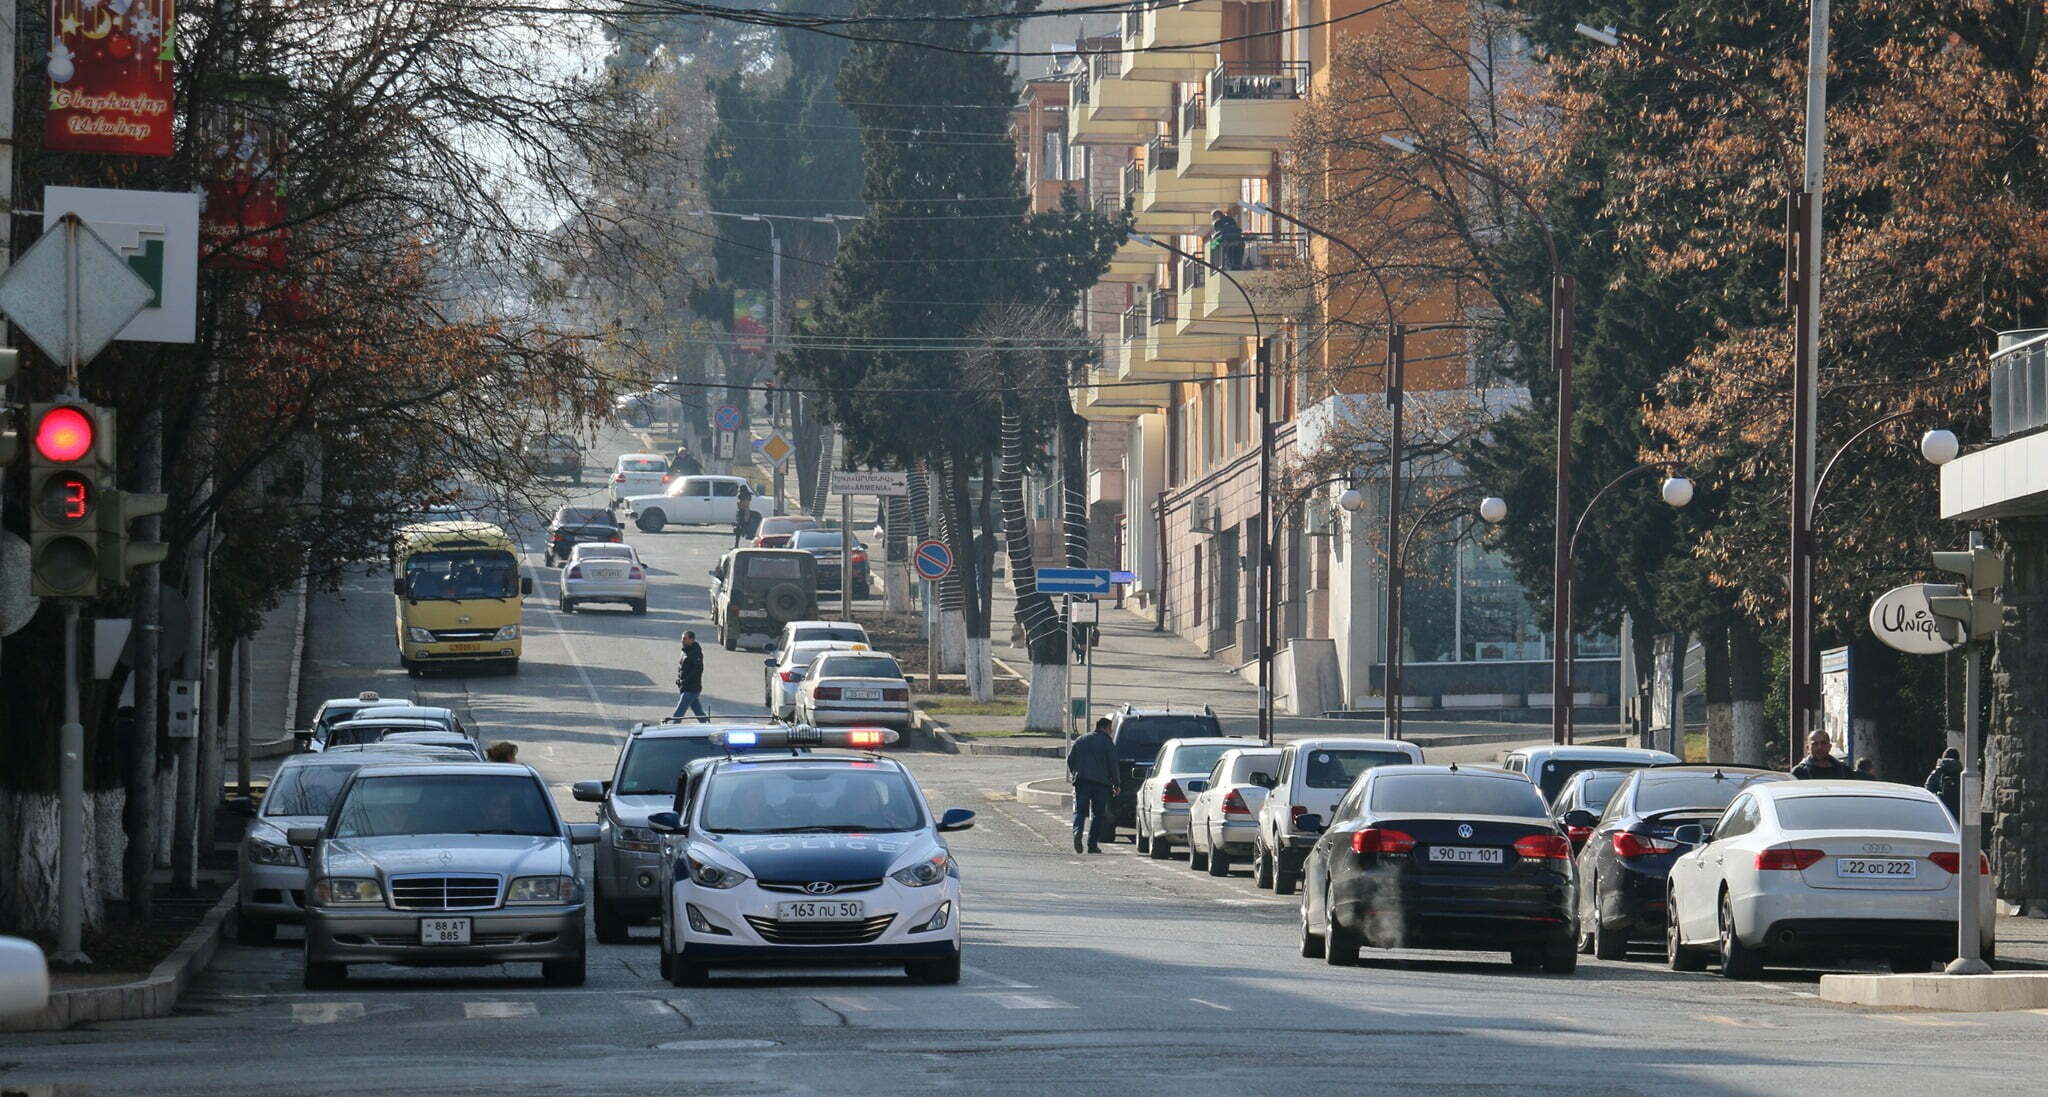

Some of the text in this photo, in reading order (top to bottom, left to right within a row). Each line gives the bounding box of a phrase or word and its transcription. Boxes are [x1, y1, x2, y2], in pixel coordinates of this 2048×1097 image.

[67, 115, 151, 140] Ամանոր
[65, 480, 86, 518] 3
[738, 839, 897, 854] POLICE
[1439, 848, 1454, 860] 90
[1478, 850, 1498, 861] 101
[1849, 861, 1865, 873] 22
[1887, 862, 1911, 874] 222
[791, 903, 815, 917] 163
[840, 903, 857, 917] 50
[435, 921, 465, 931] 88 AT
